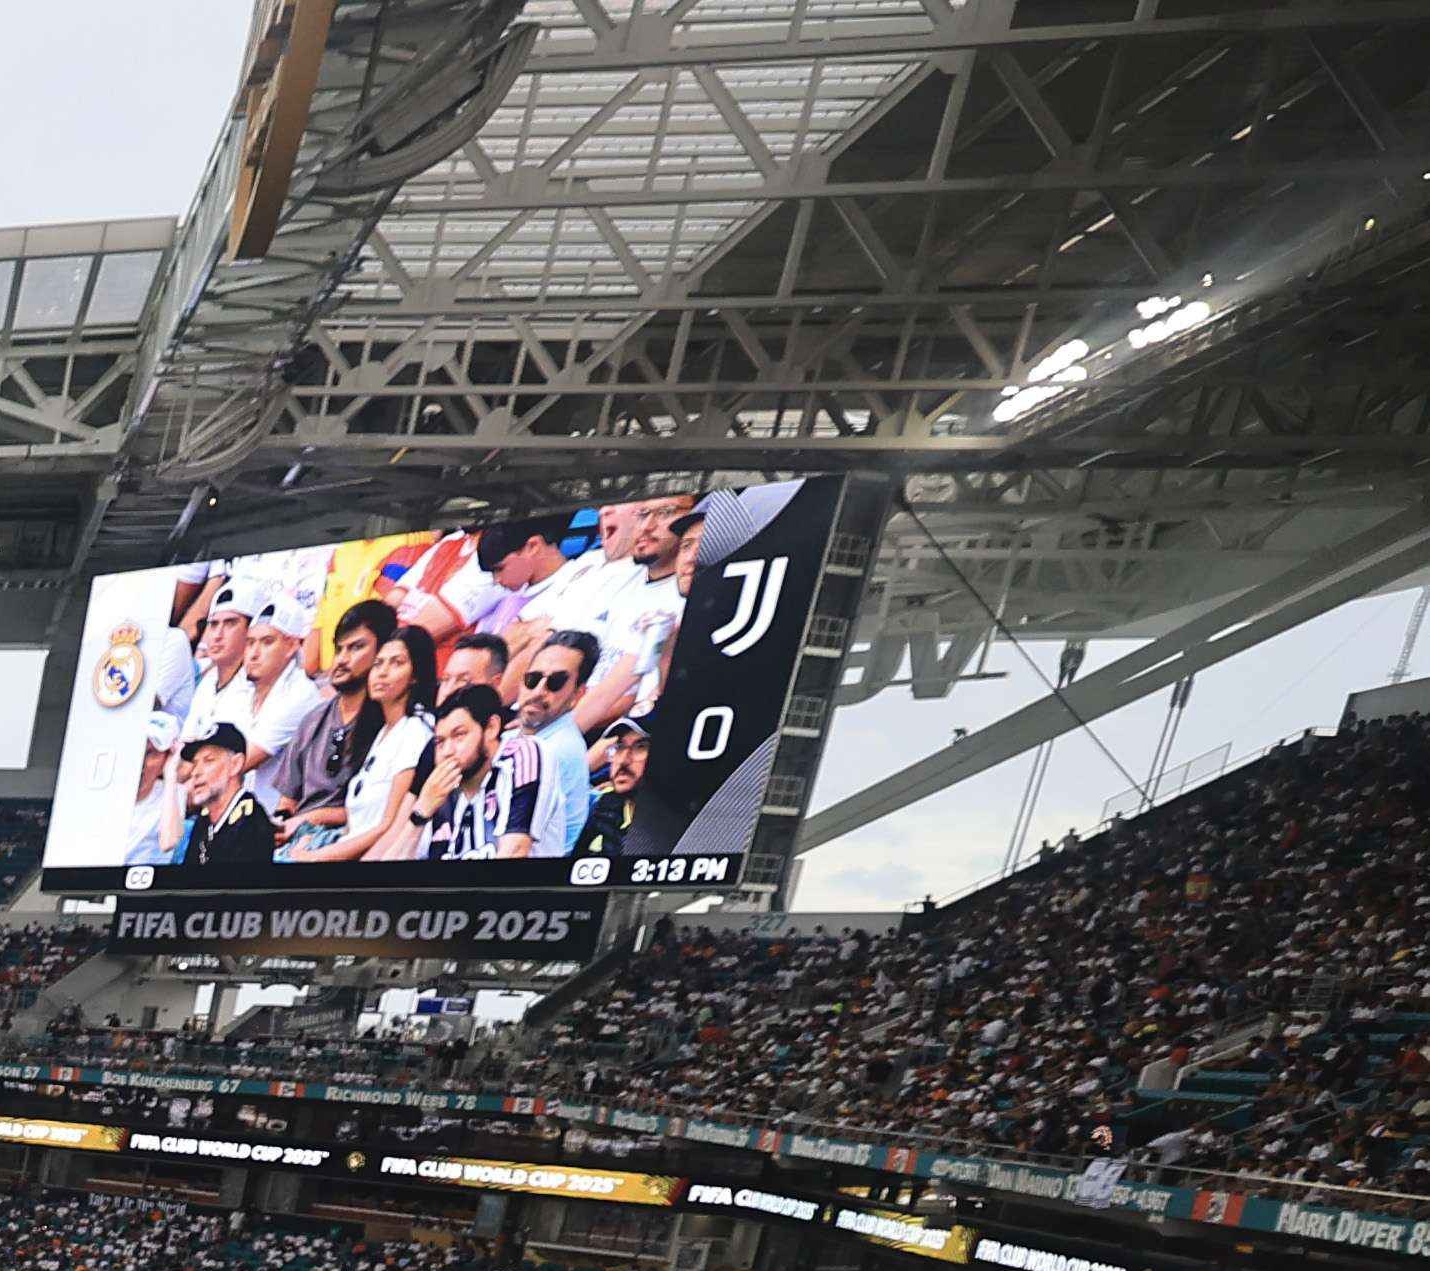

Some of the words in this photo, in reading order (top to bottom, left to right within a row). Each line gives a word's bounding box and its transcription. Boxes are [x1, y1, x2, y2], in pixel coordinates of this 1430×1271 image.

[687, 706, 733, 760] 0
[631, 858, 687, 881] 3:13
[689, 857, 729, 881] PM
[117, 912, 177, 940] FIFA
[183, 911, 261, 940] CLUB
[270, 908, 390, 940] WORLD
[395, 909, 468, 940] CUP
[130, 1134, 160, 1150] FIFA
[161, 1136, 197, 1153] CLUB
[198, 1139, 251, 1158] WORLD
[251, 1144, 282, 1162] CUP
[1275, 1202, 1336, 1241] MARK
[1335, 1211, 1406, 1251] DUPER
